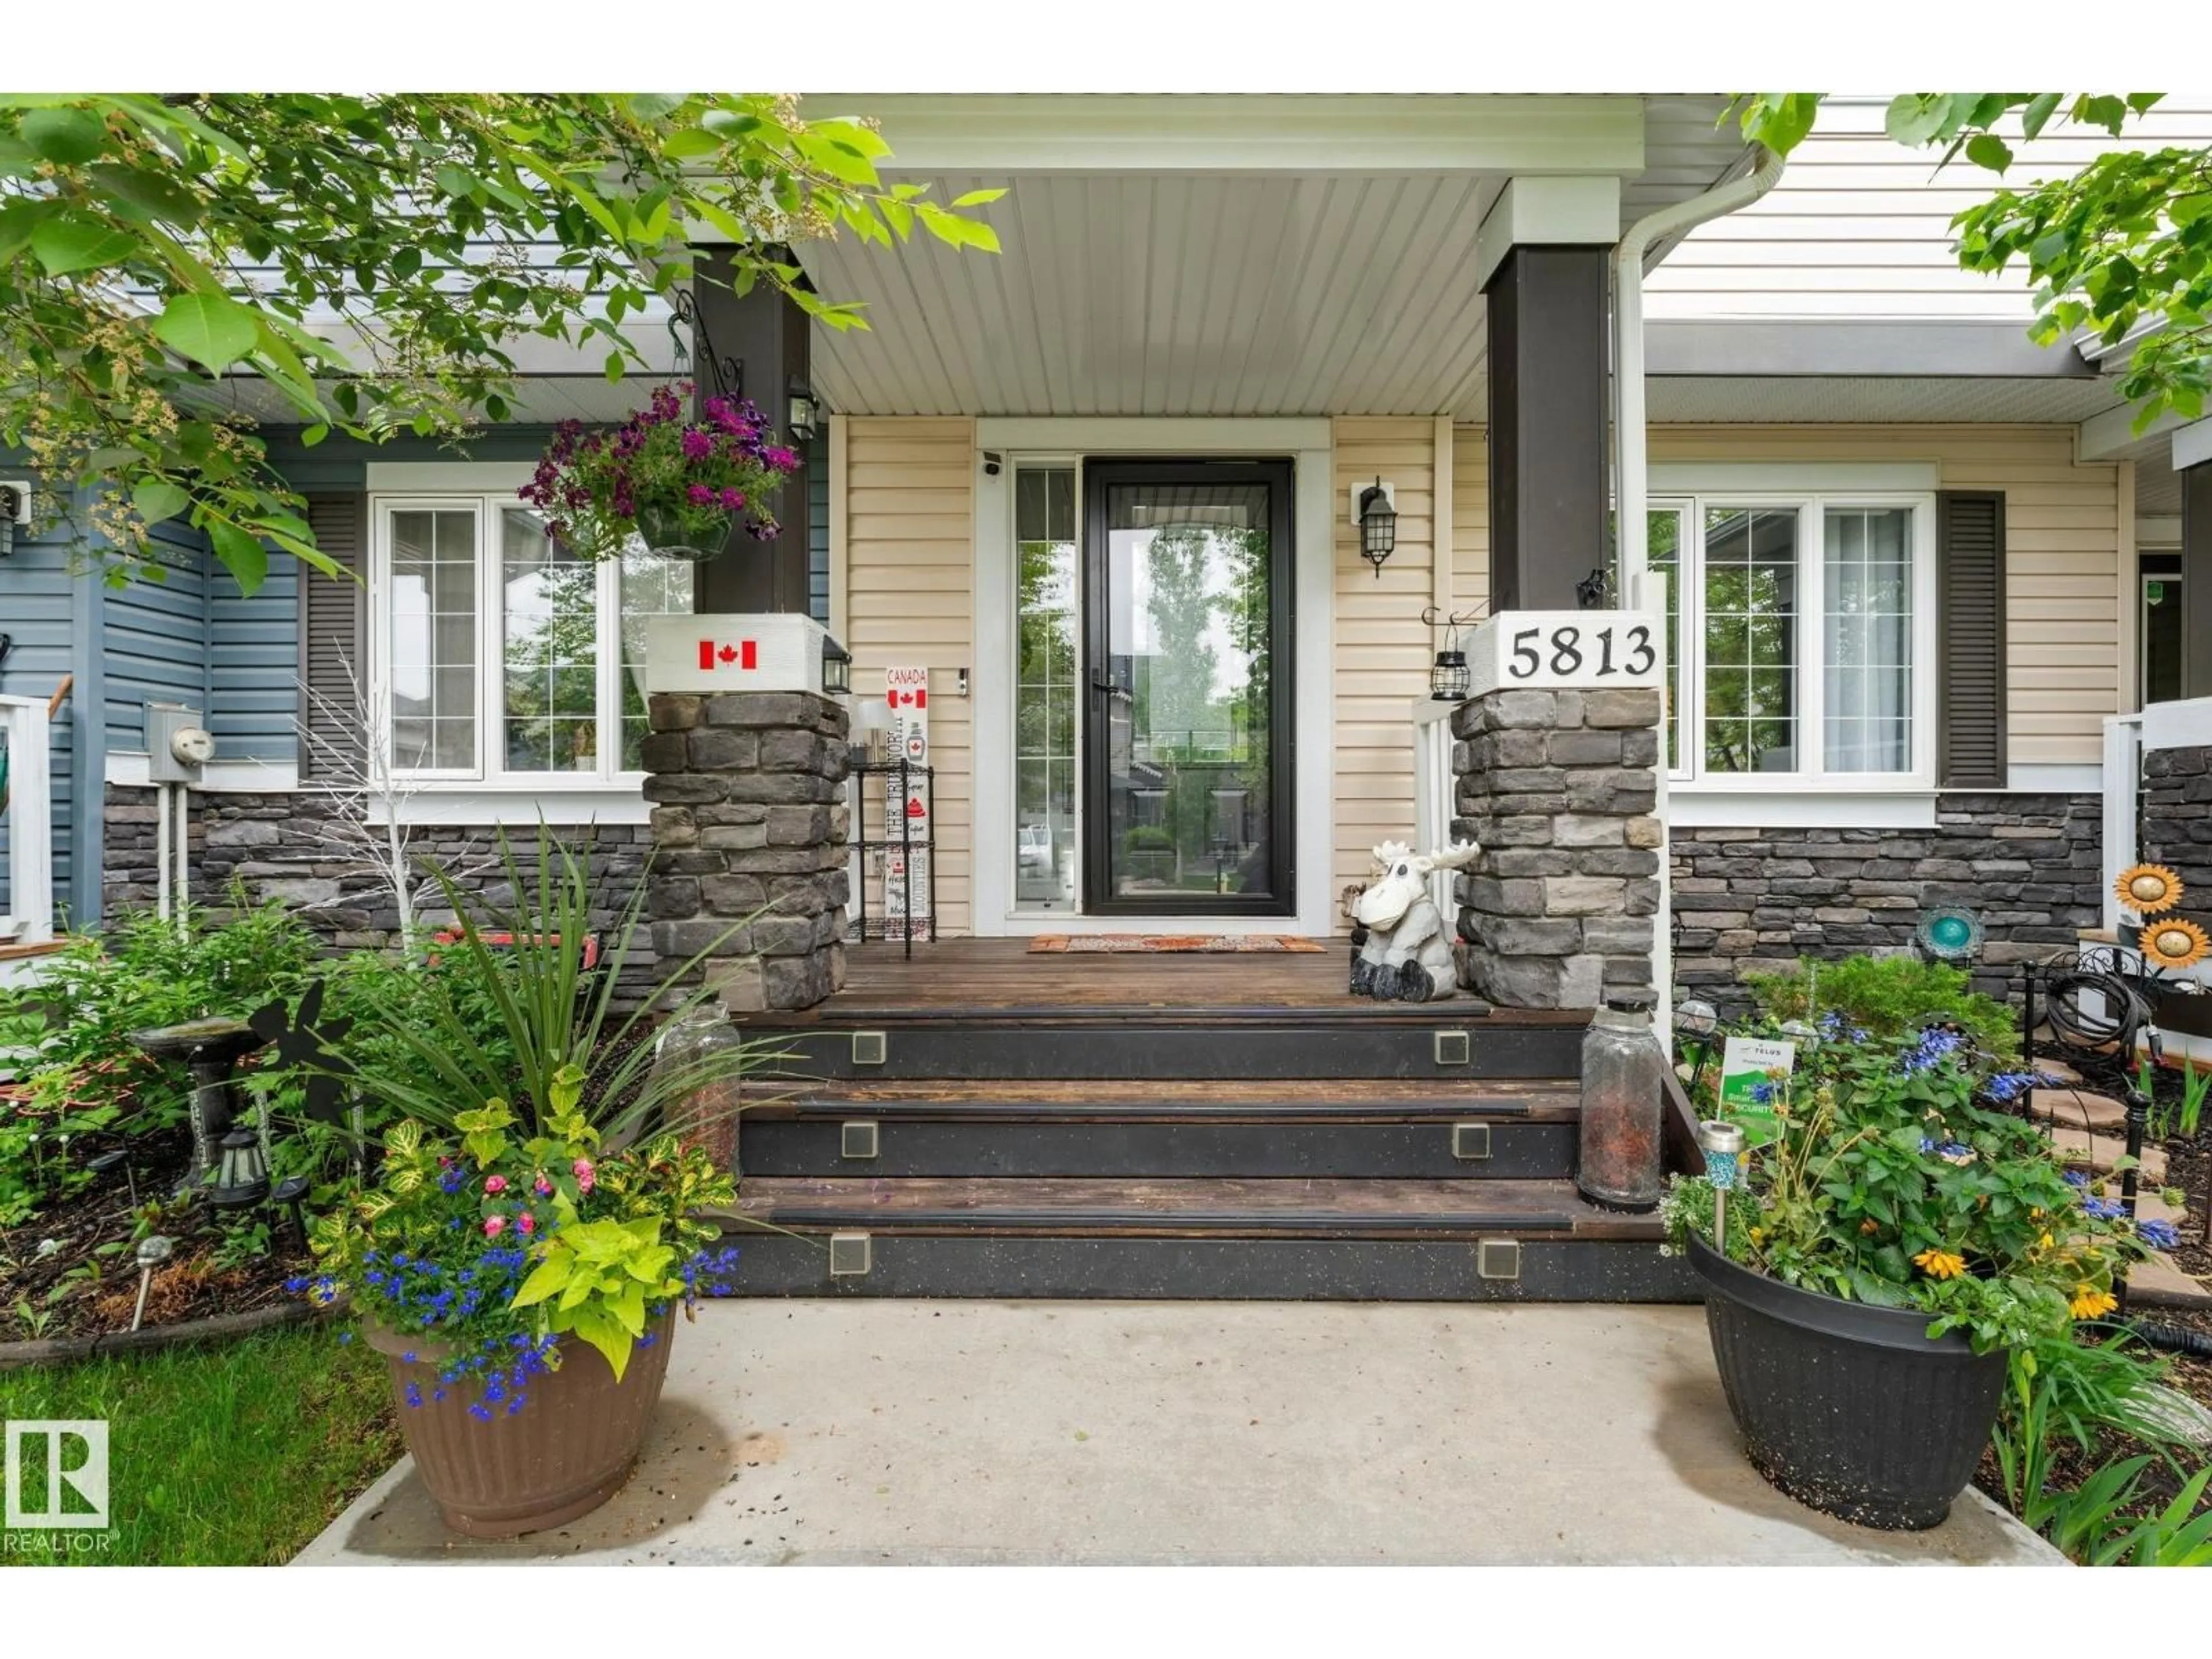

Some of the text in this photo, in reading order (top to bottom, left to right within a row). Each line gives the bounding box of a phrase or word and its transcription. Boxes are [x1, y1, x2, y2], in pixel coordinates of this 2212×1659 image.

[1508, 625, 1656, 679] 5813
[888, 669, 926, 684] CANADA
[887, 809, 902, 835] THE
[1755, 1047, 1781, 1056] TELUS
